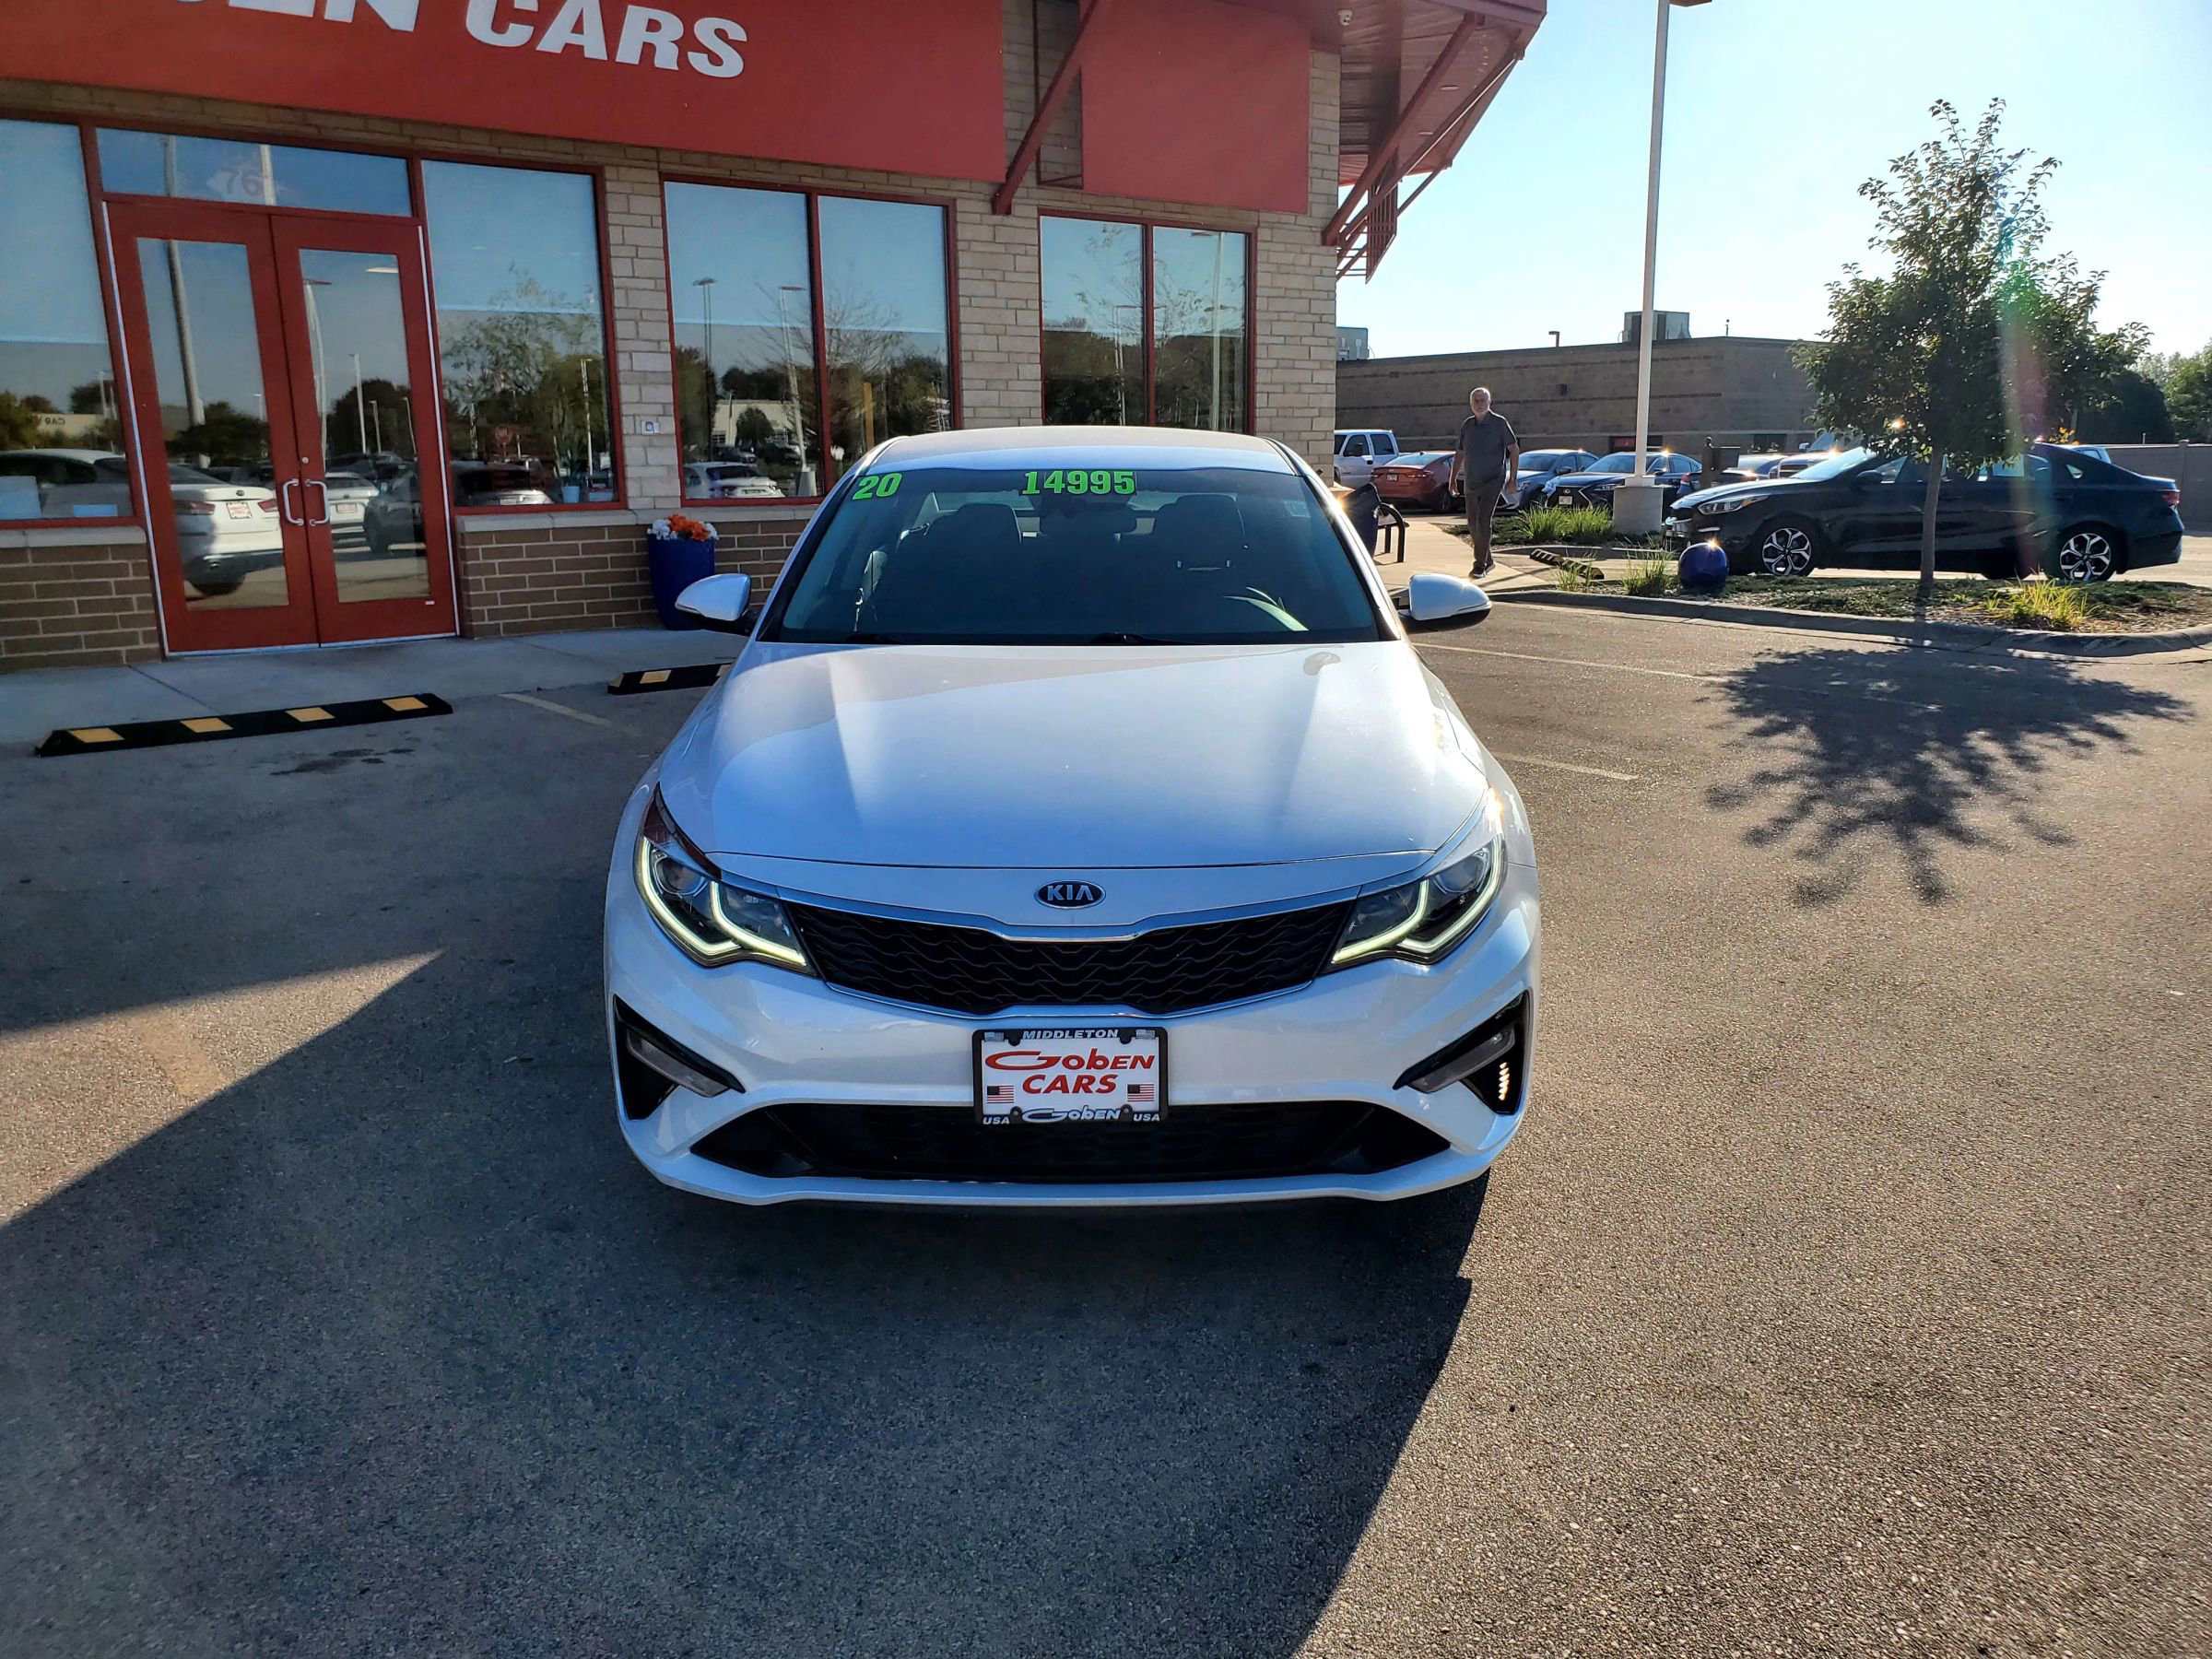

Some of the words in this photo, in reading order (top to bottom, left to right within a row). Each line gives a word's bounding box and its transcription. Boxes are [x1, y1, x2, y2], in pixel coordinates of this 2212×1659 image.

[465, 0, 747, 77] CARS
[853, 473, 903, 500] 20
[1022, 470, 1136, 495] 14995
[1047, 885, 1094, 901] KIA
[1022, 1029, 1119, 1040] MIDDLETON
[1022, 1074, 1118, 1094] CARS
[982, 1116, 1010, 1125] USA
[1133, 1112, 1161, 1122] USA
